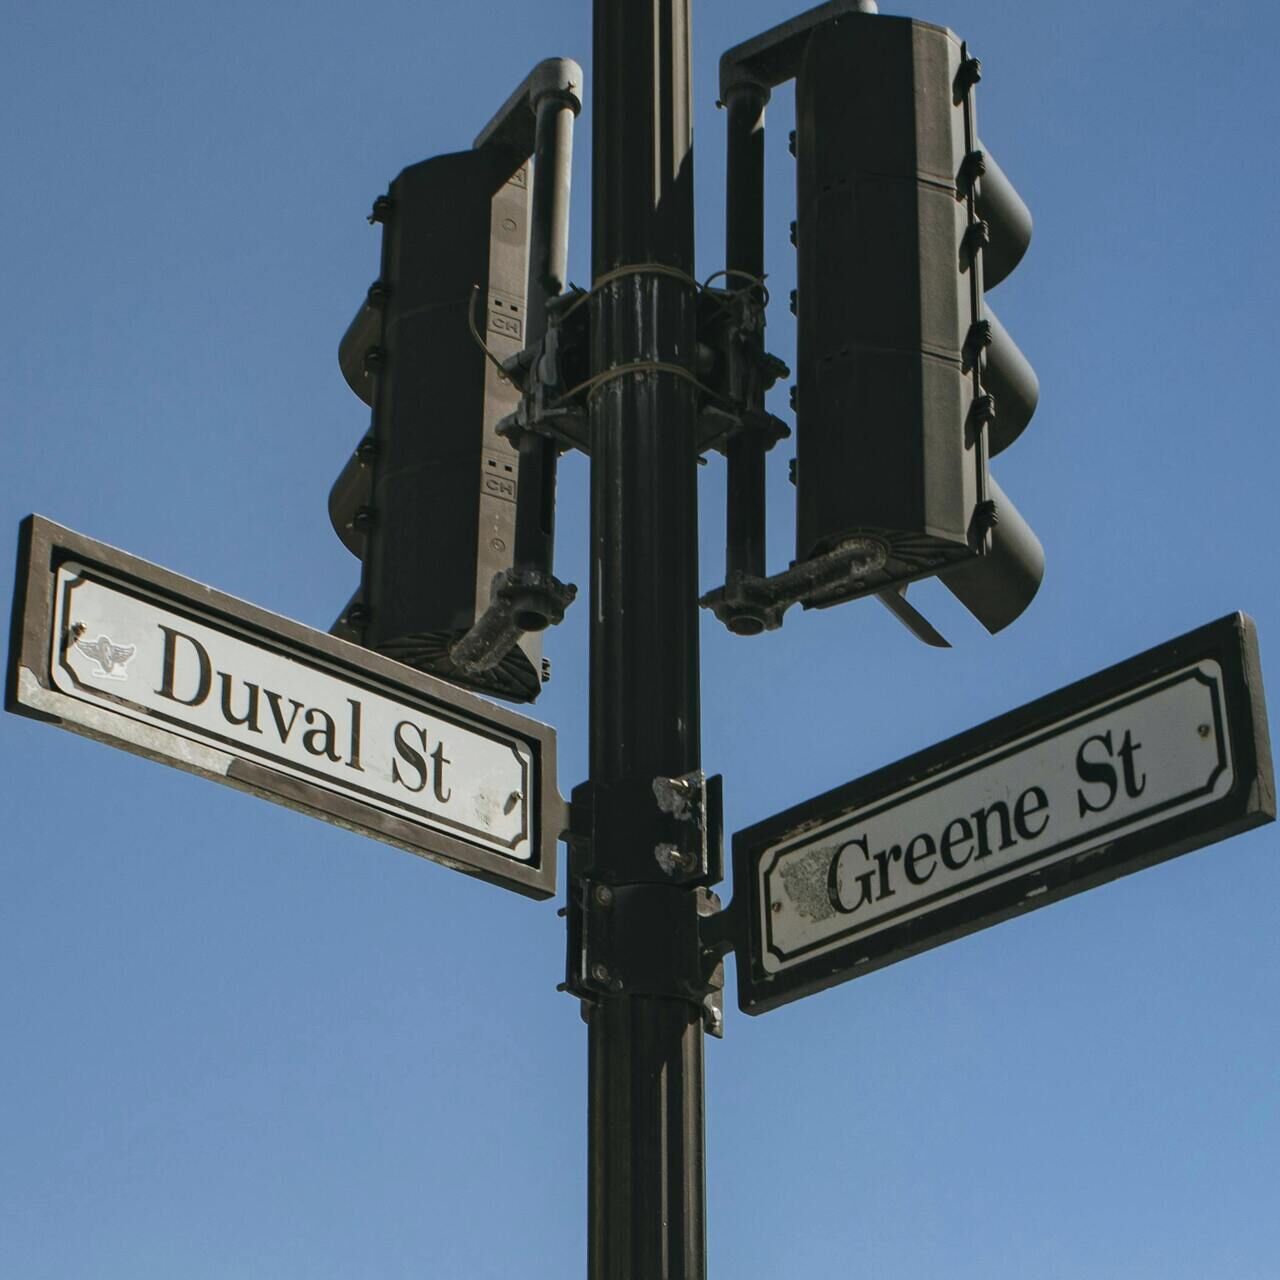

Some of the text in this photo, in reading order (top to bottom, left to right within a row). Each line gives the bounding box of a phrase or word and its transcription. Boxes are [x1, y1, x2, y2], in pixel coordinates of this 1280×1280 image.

[153, 623, 452, 804] Duval St
[826, 727, 1147, 915] Greene St
